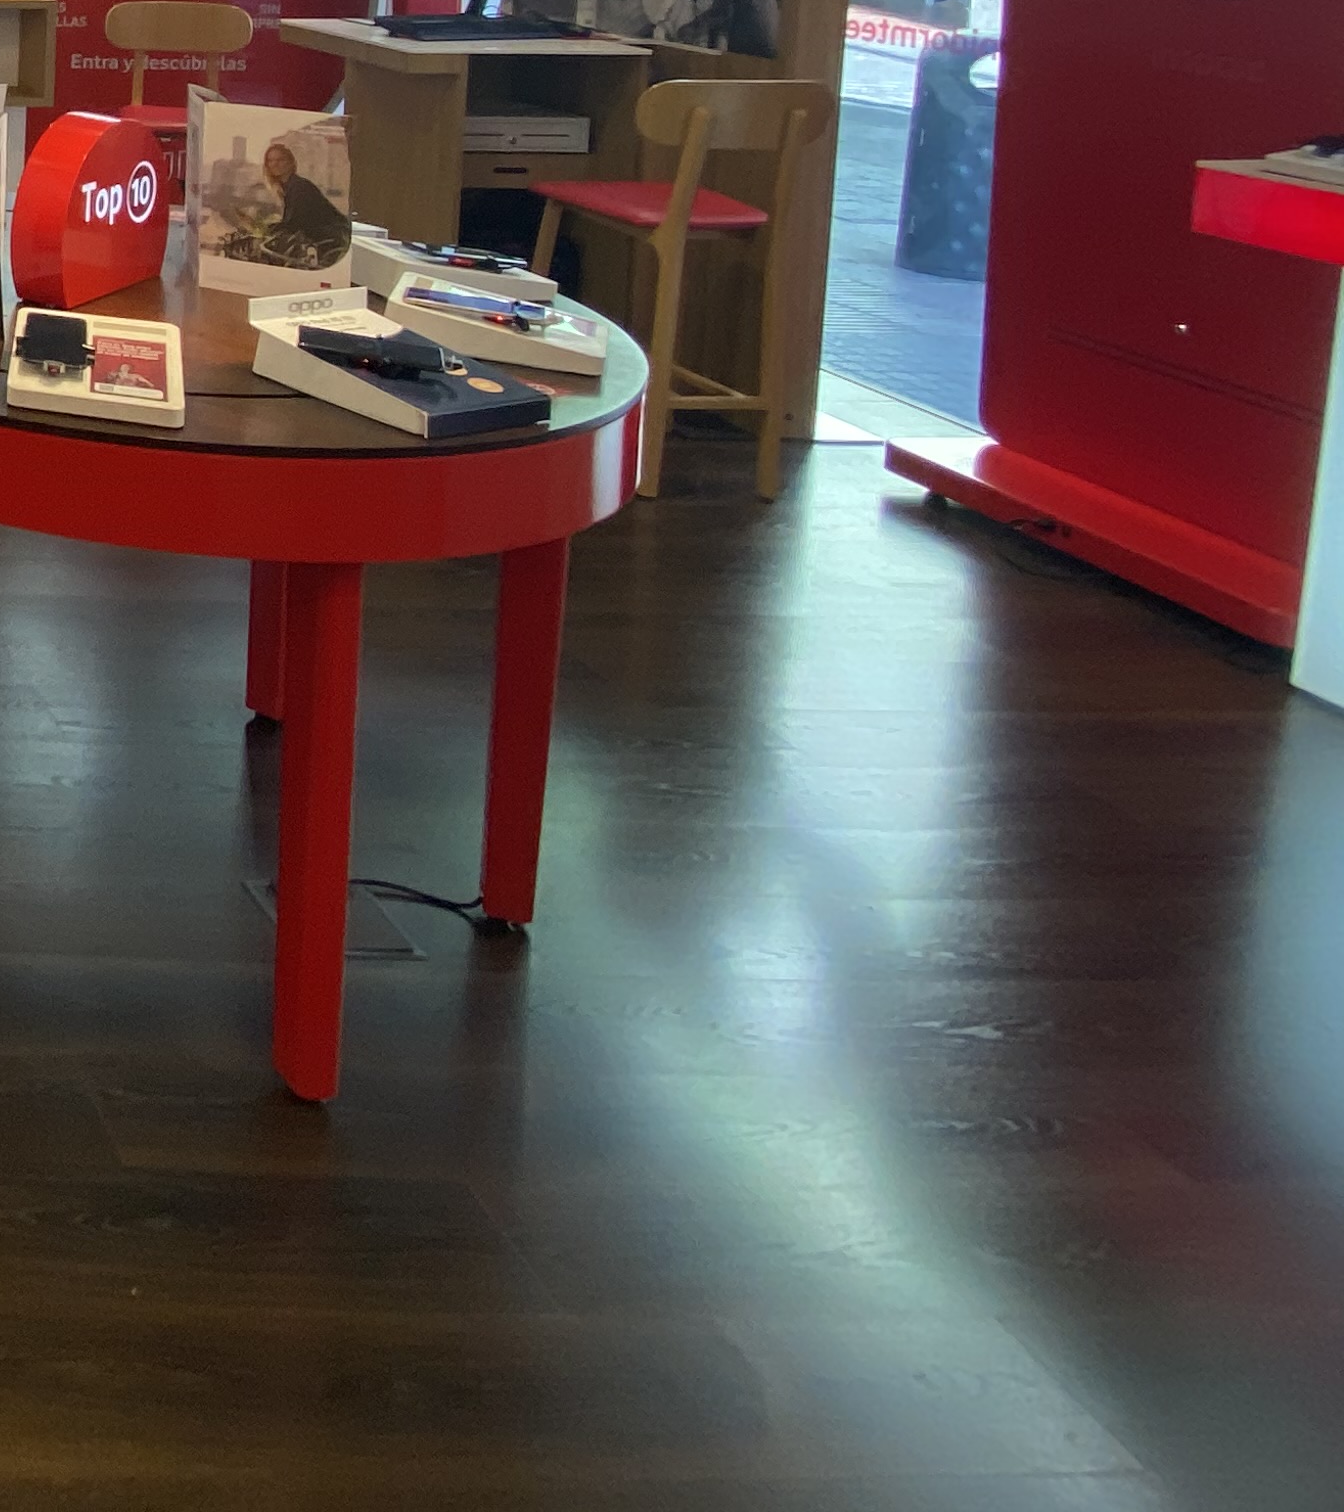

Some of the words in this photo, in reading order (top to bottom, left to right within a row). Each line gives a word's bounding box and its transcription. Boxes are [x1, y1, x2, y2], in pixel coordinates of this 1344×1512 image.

[70, 53, 119, 71] Entra
[122, 57, 134, 73] y
[81, 181, 123, 225] Top
[131, 175, 151, 207] 10
[288, 297, 333, 315] oppo
